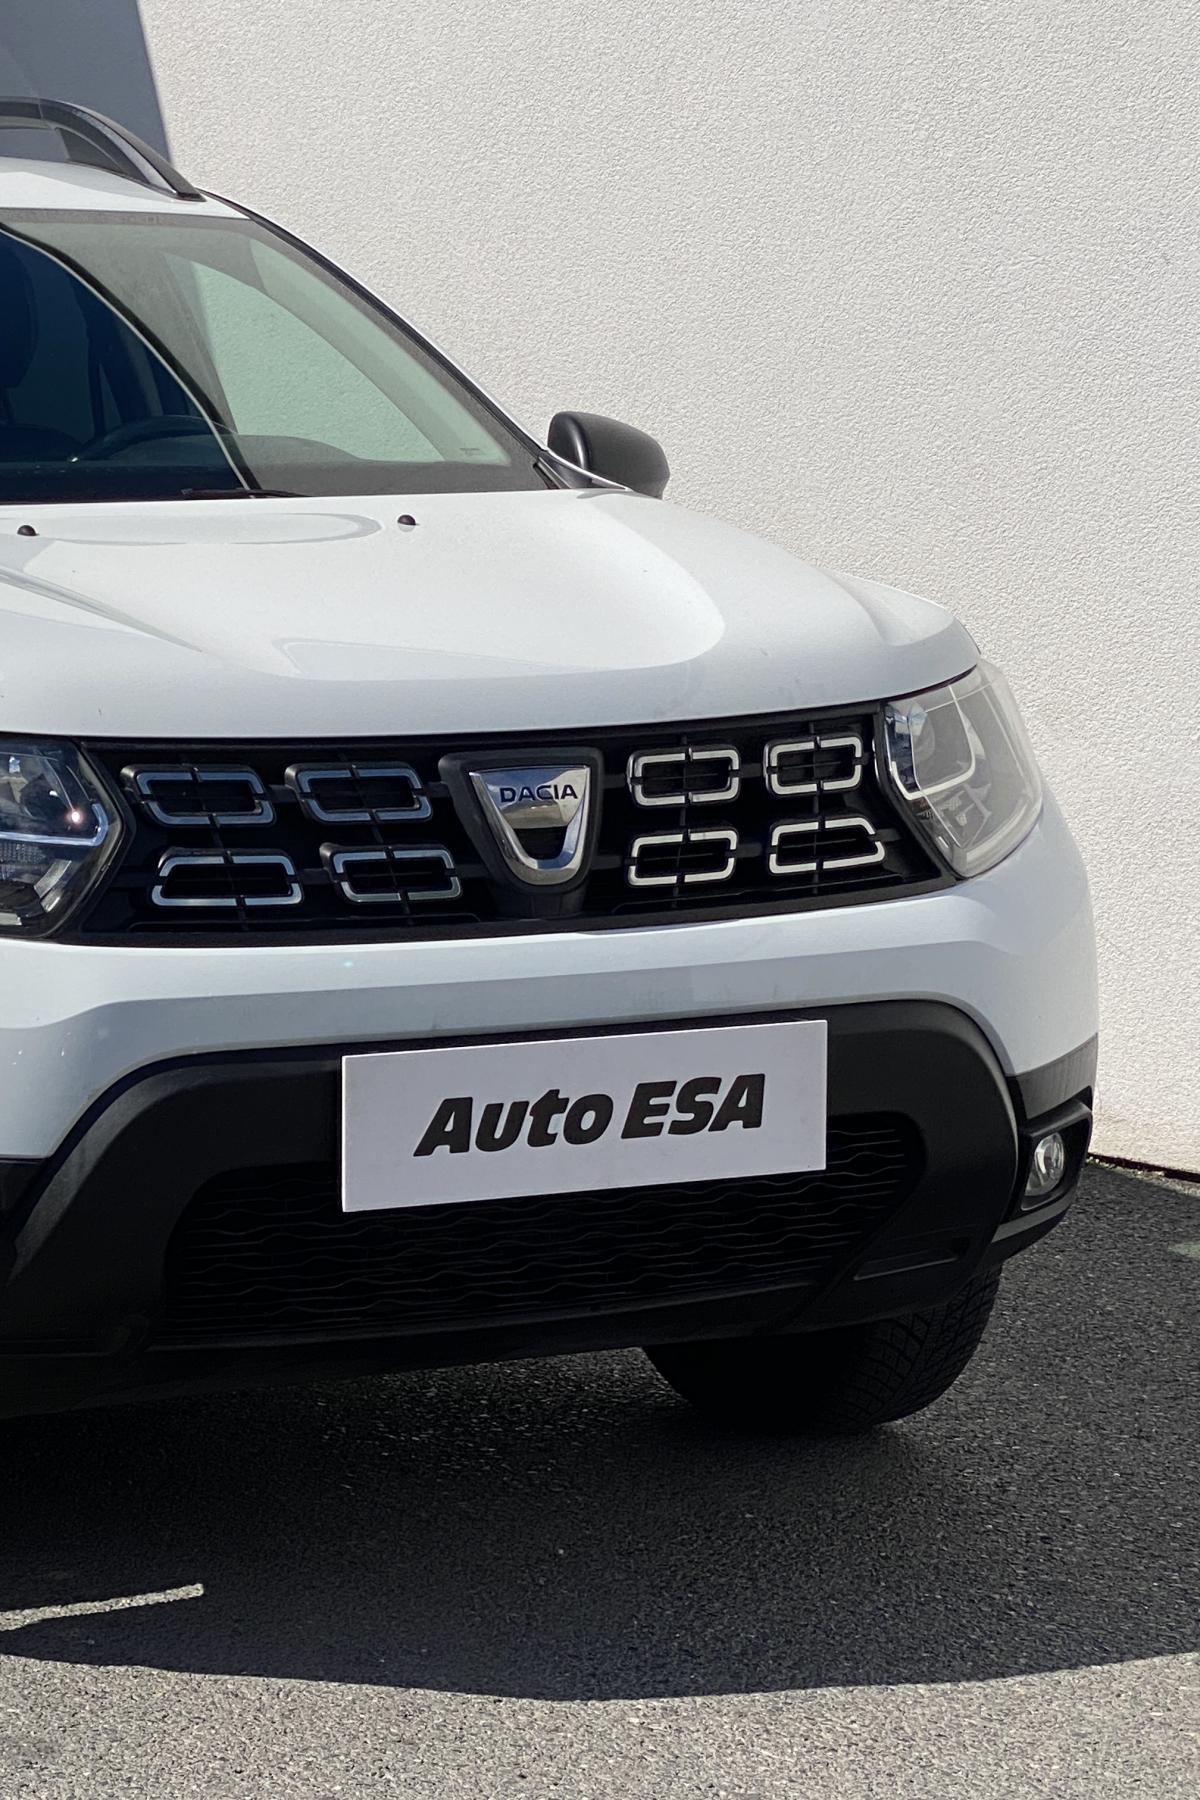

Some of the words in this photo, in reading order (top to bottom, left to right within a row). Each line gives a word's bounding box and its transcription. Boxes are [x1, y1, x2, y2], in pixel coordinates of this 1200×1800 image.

[500, 784, 578, 802] DACIA
[412, 1088, 614, 1157] Auto
[620, 1073, 766, 1140] ESA
